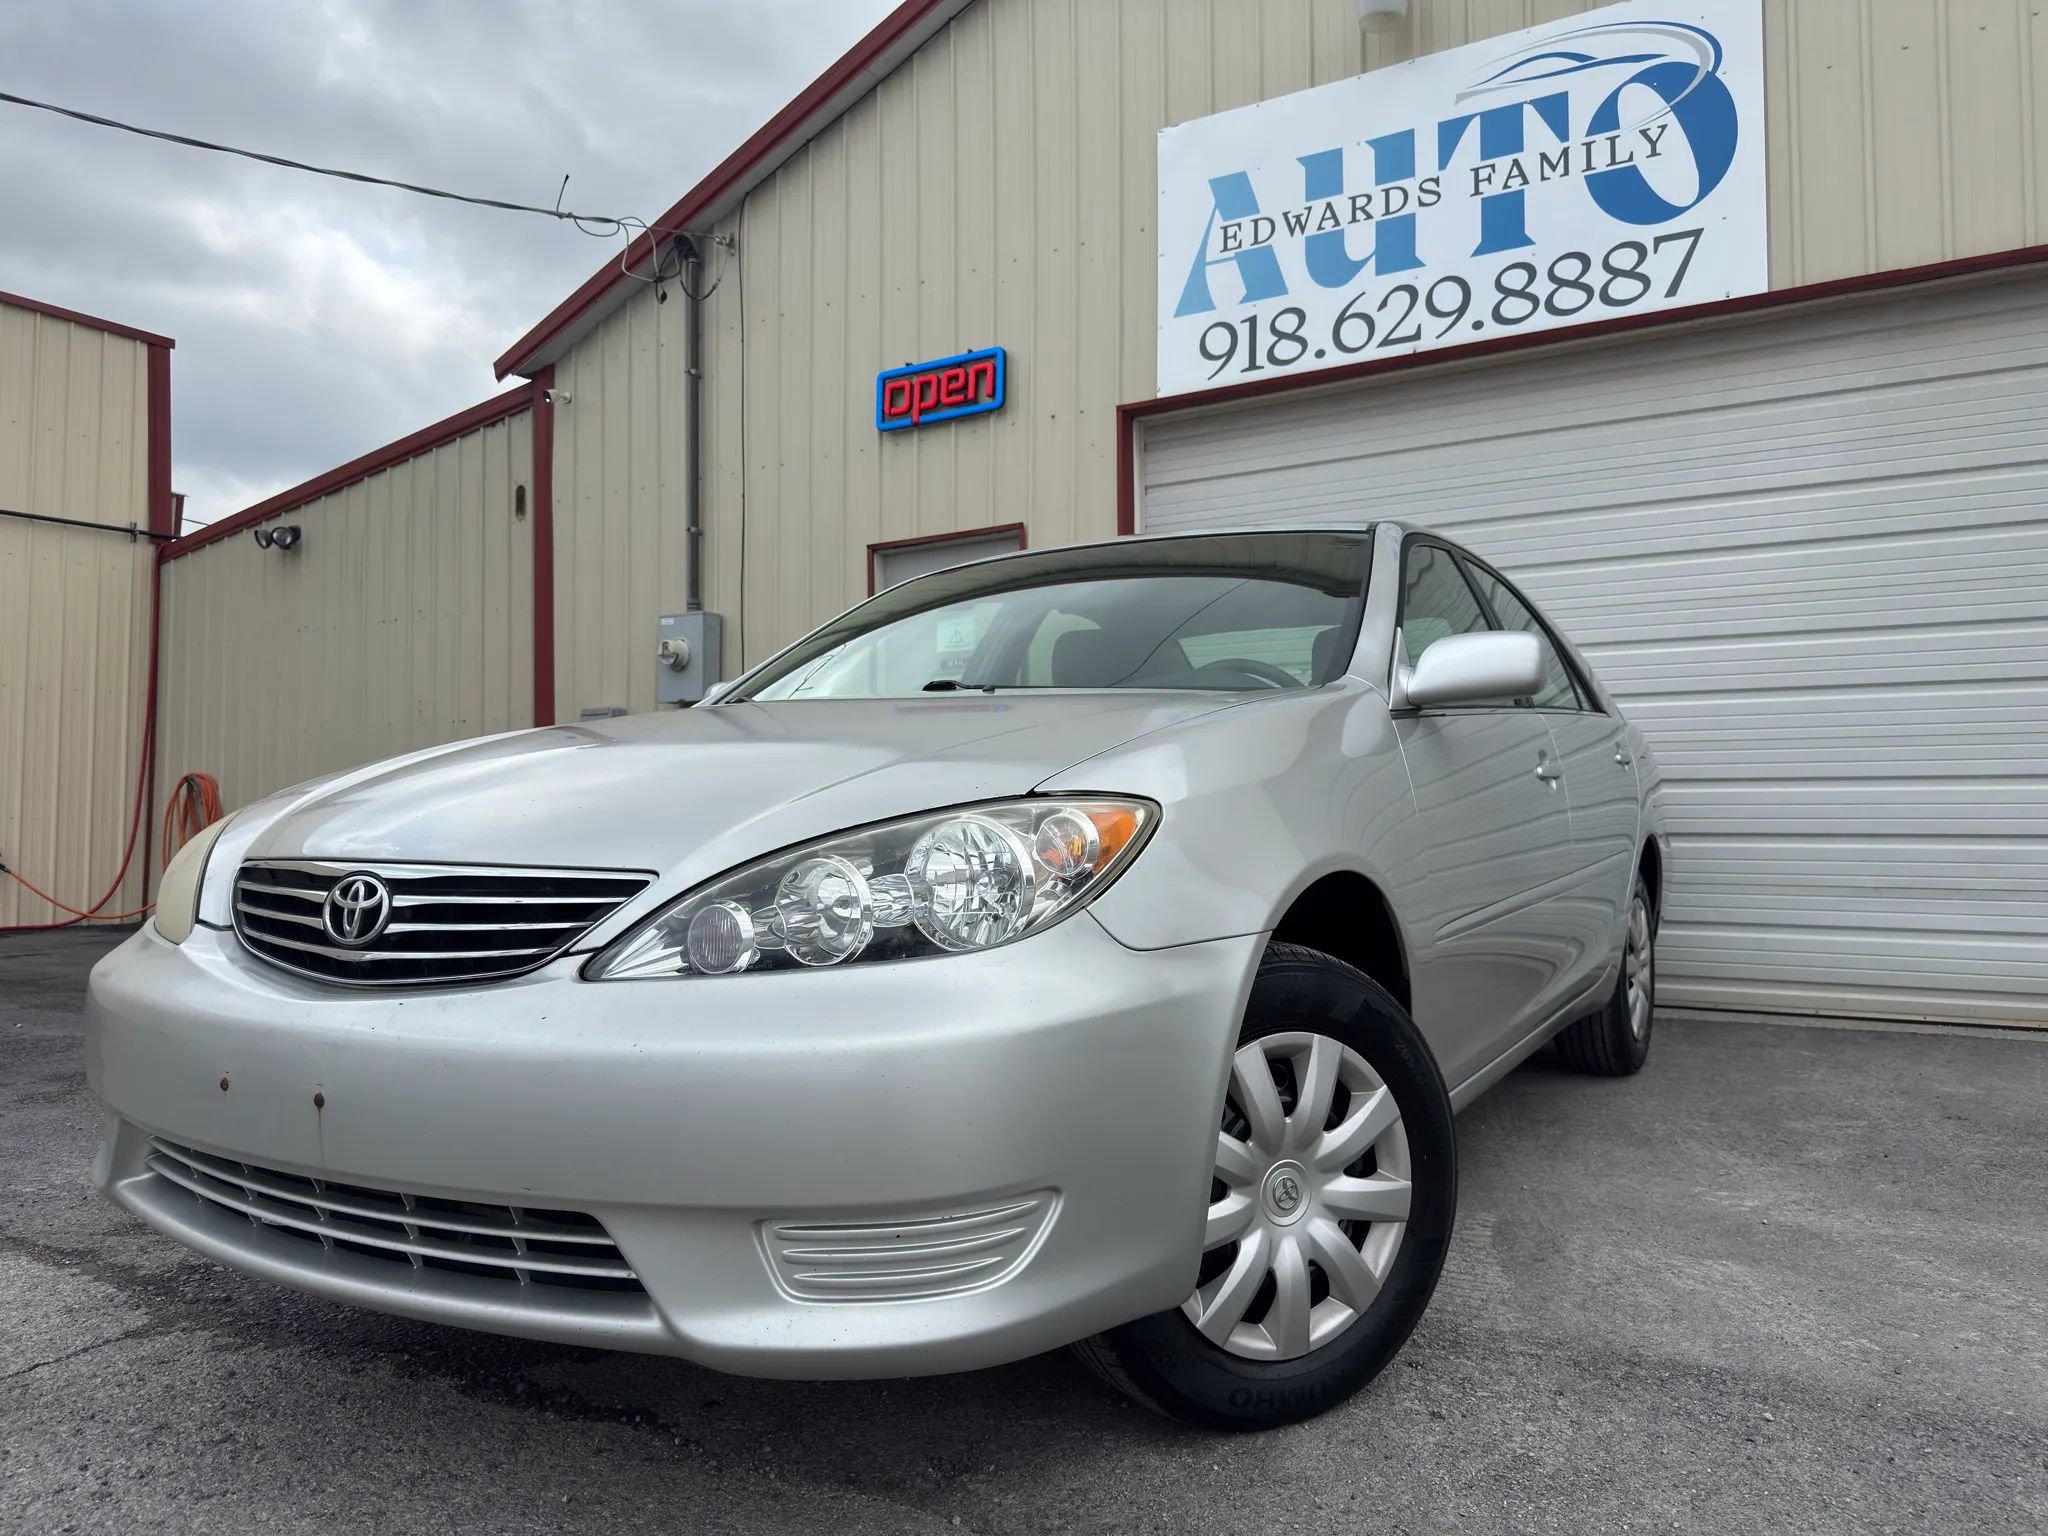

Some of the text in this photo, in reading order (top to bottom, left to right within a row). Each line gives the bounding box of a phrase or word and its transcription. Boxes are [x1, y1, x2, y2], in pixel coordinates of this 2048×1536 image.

[1173, 61, 1738, 318] AUTO
[1220, 124, 1668, 254] EDWARDS FAMILY
[1199, 227, 1705, 381] 918.629.8887
[884, 361, 995, 425] open
